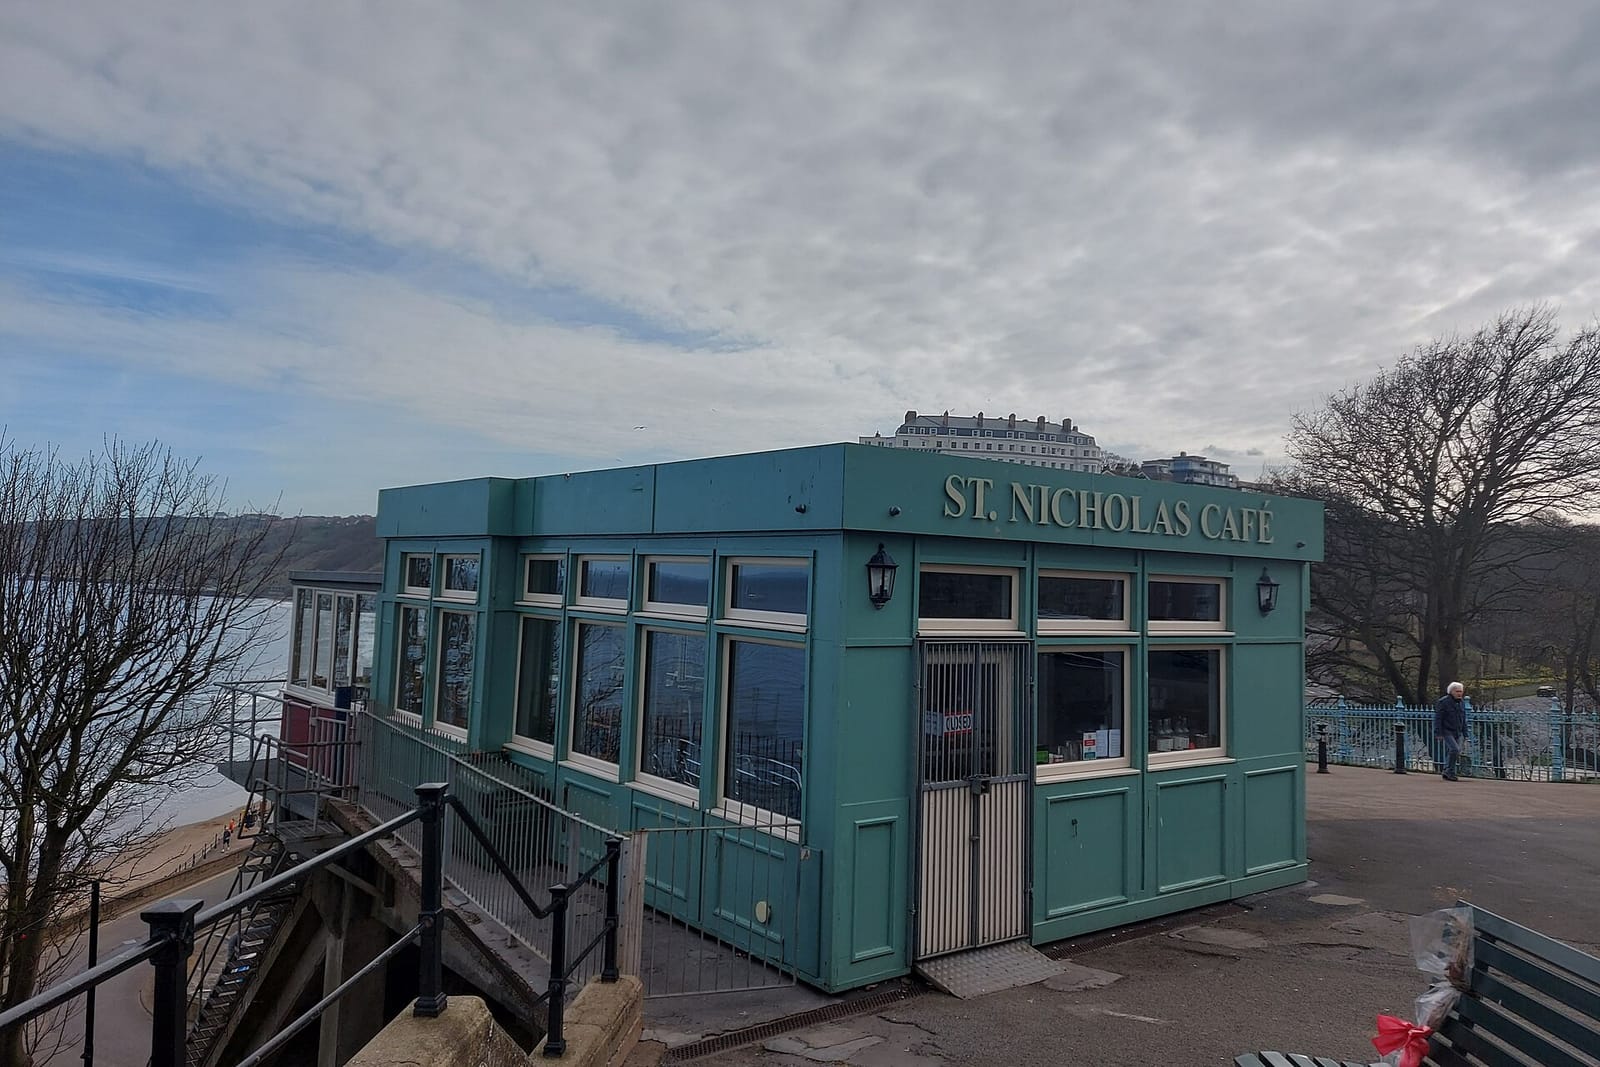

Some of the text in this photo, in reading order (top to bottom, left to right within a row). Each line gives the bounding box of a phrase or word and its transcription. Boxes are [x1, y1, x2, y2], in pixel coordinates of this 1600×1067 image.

[944, 474, 1275, 544] ST. NICHOLAS CAFÉ
